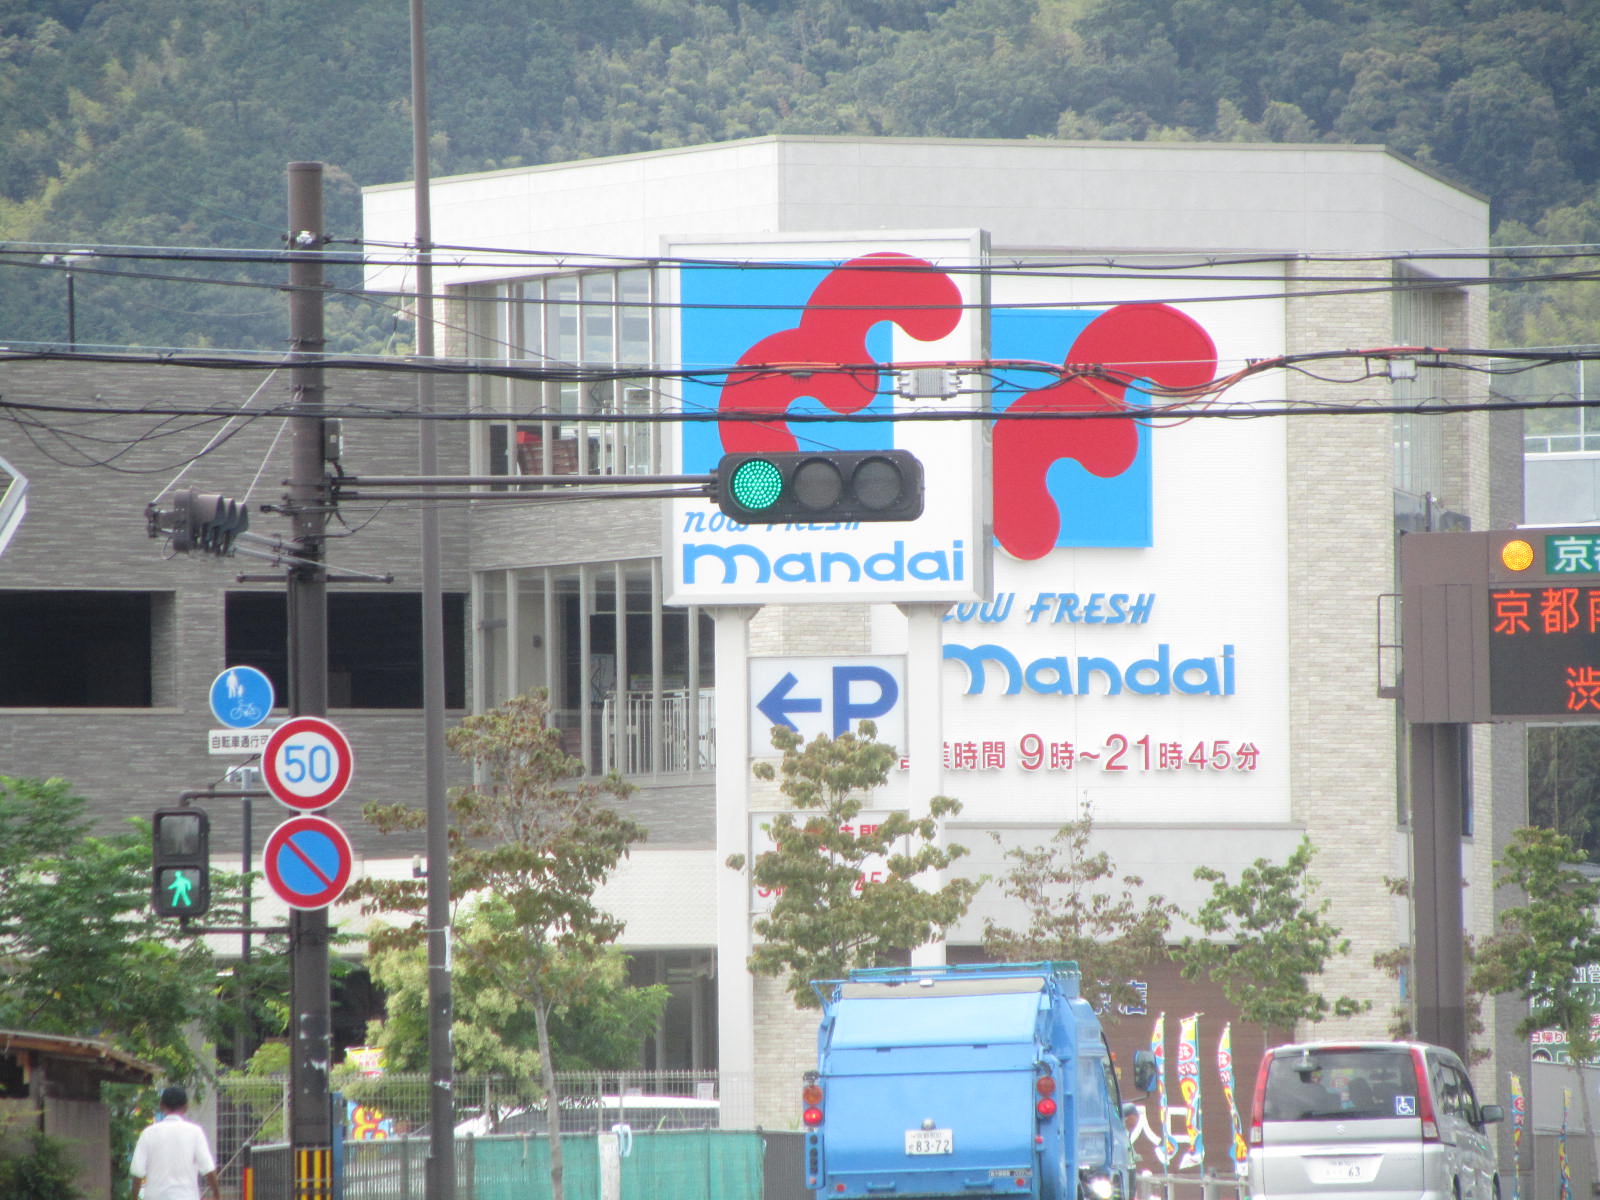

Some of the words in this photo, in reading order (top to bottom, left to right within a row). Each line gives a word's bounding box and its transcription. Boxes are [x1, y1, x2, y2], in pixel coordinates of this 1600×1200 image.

[683, 540, 964, 584] mandai
[1554, 536, 1600, 572] 京
[1026, 593, 1156, 625] FRESH
[1492, 588, 1600, 635] 京都
[942, 644, 1235, 696] mandai
[832, 666, 898, 740] P
[284, 745, 332, 783] 50
